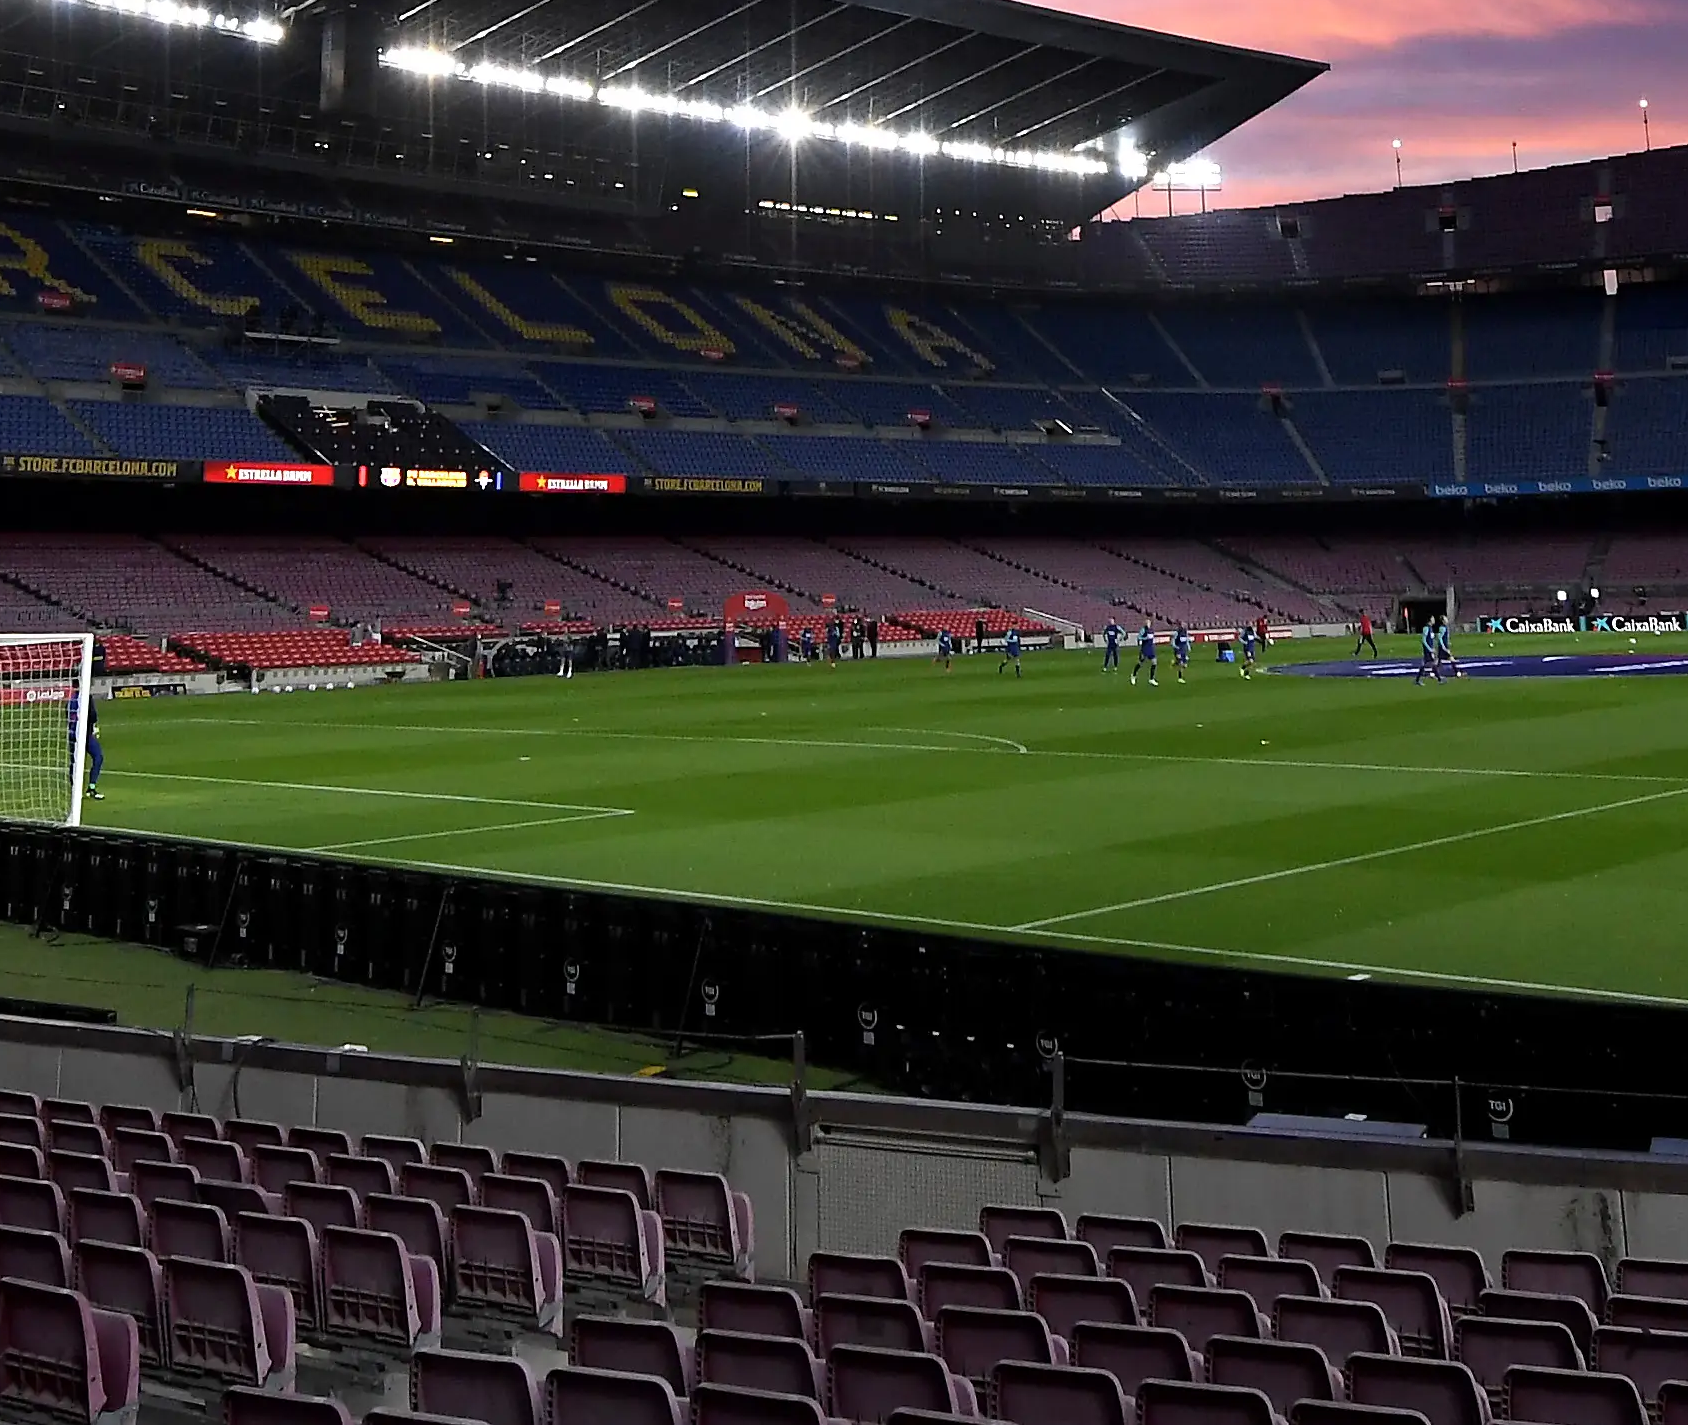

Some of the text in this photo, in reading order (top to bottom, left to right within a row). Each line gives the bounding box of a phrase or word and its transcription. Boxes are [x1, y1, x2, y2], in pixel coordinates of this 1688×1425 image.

[18, 457, 178, 477] STORE.FCBARCELONA.COM
[238, 468, 282, 481] ESTRELLA
[547, 478, 583, 490] ESTRELLA
[1485, 483, 1518, 494] beko
[1538, 481, 1572, 492] beko
[1592, 478, 1627, 490] beko
[1648, 477, 1682, 488] beko
[1435, 485, 1468, 496] beko
[1506, 618, 1575, 633] CaixaBank
[1611, 617, 1681, 632] CaixaBank
[37, 690, 65, 701] LaLiga
[1489, 1099, 1507, 1112] TGI
